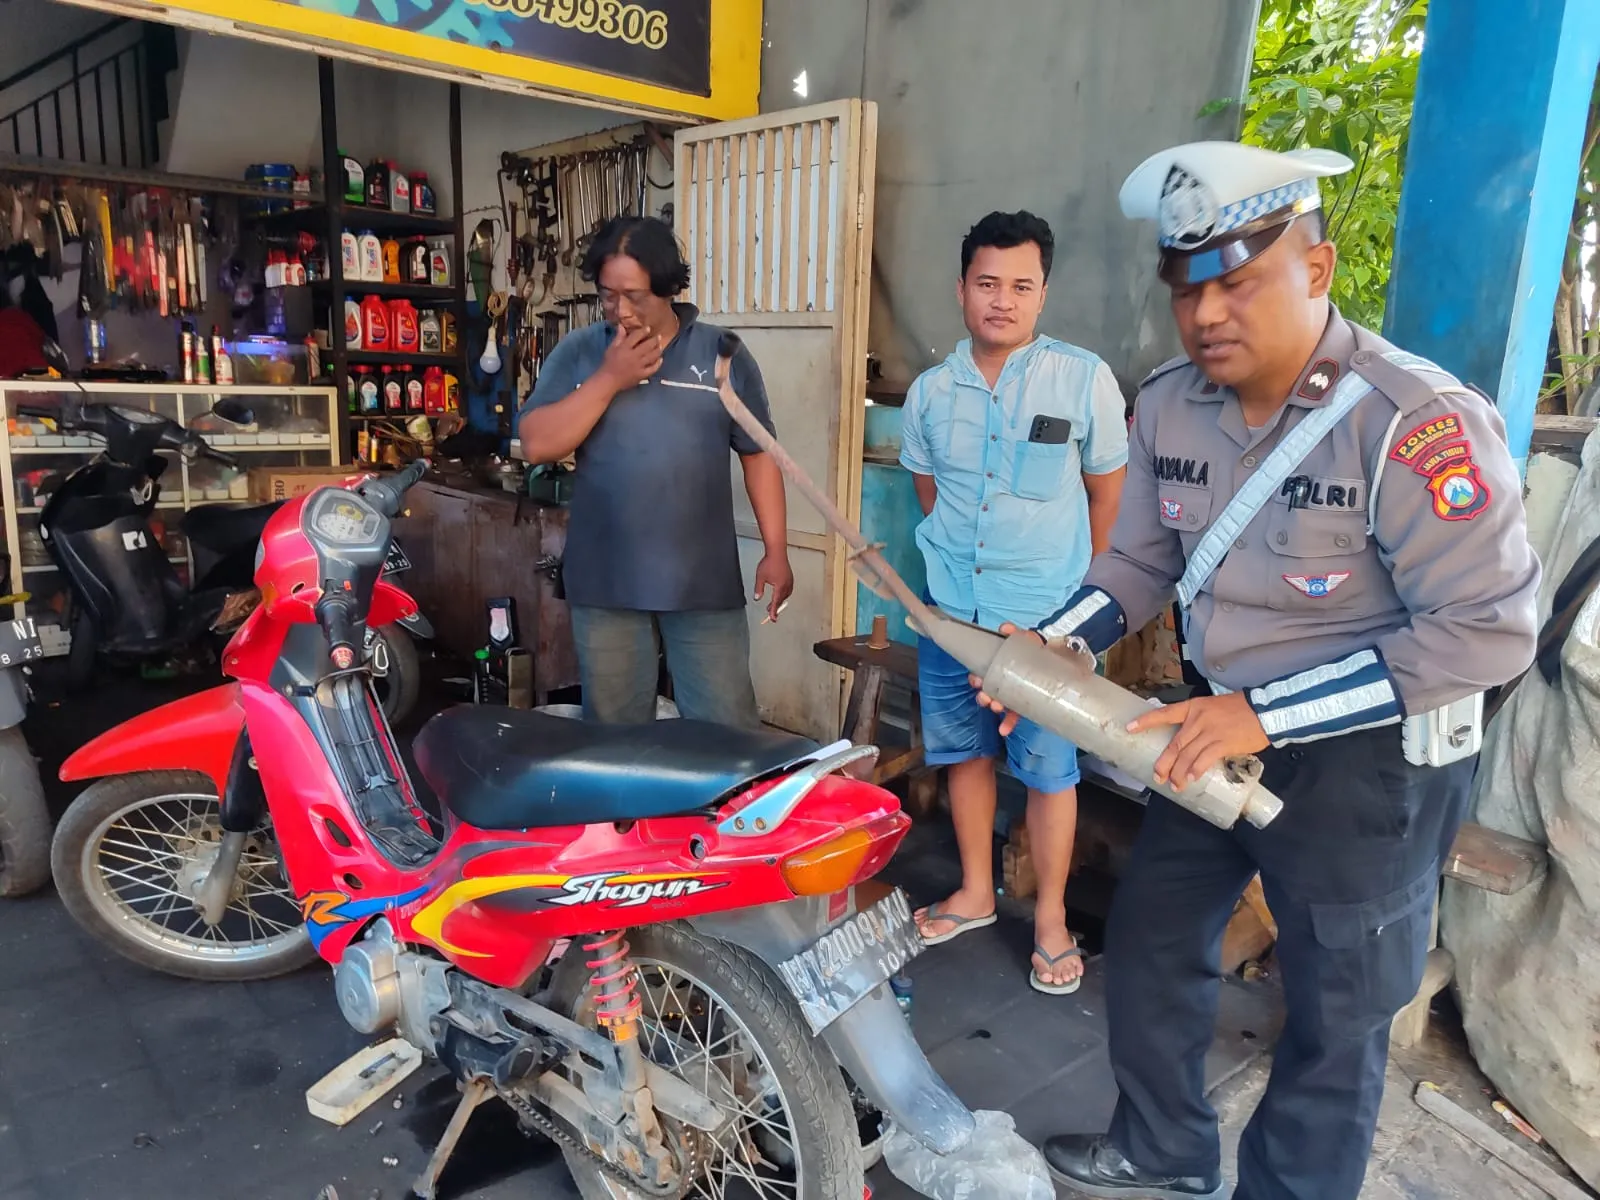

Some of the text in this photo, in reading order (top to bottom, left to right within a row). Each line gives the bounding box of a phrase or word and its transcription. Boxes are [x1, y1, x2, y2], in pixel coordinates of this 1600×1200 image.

[1398, 418, 1455, 455] POLRES
[24, 645, 42, 659] 25
[537, 871, 731, 908] Shogun
